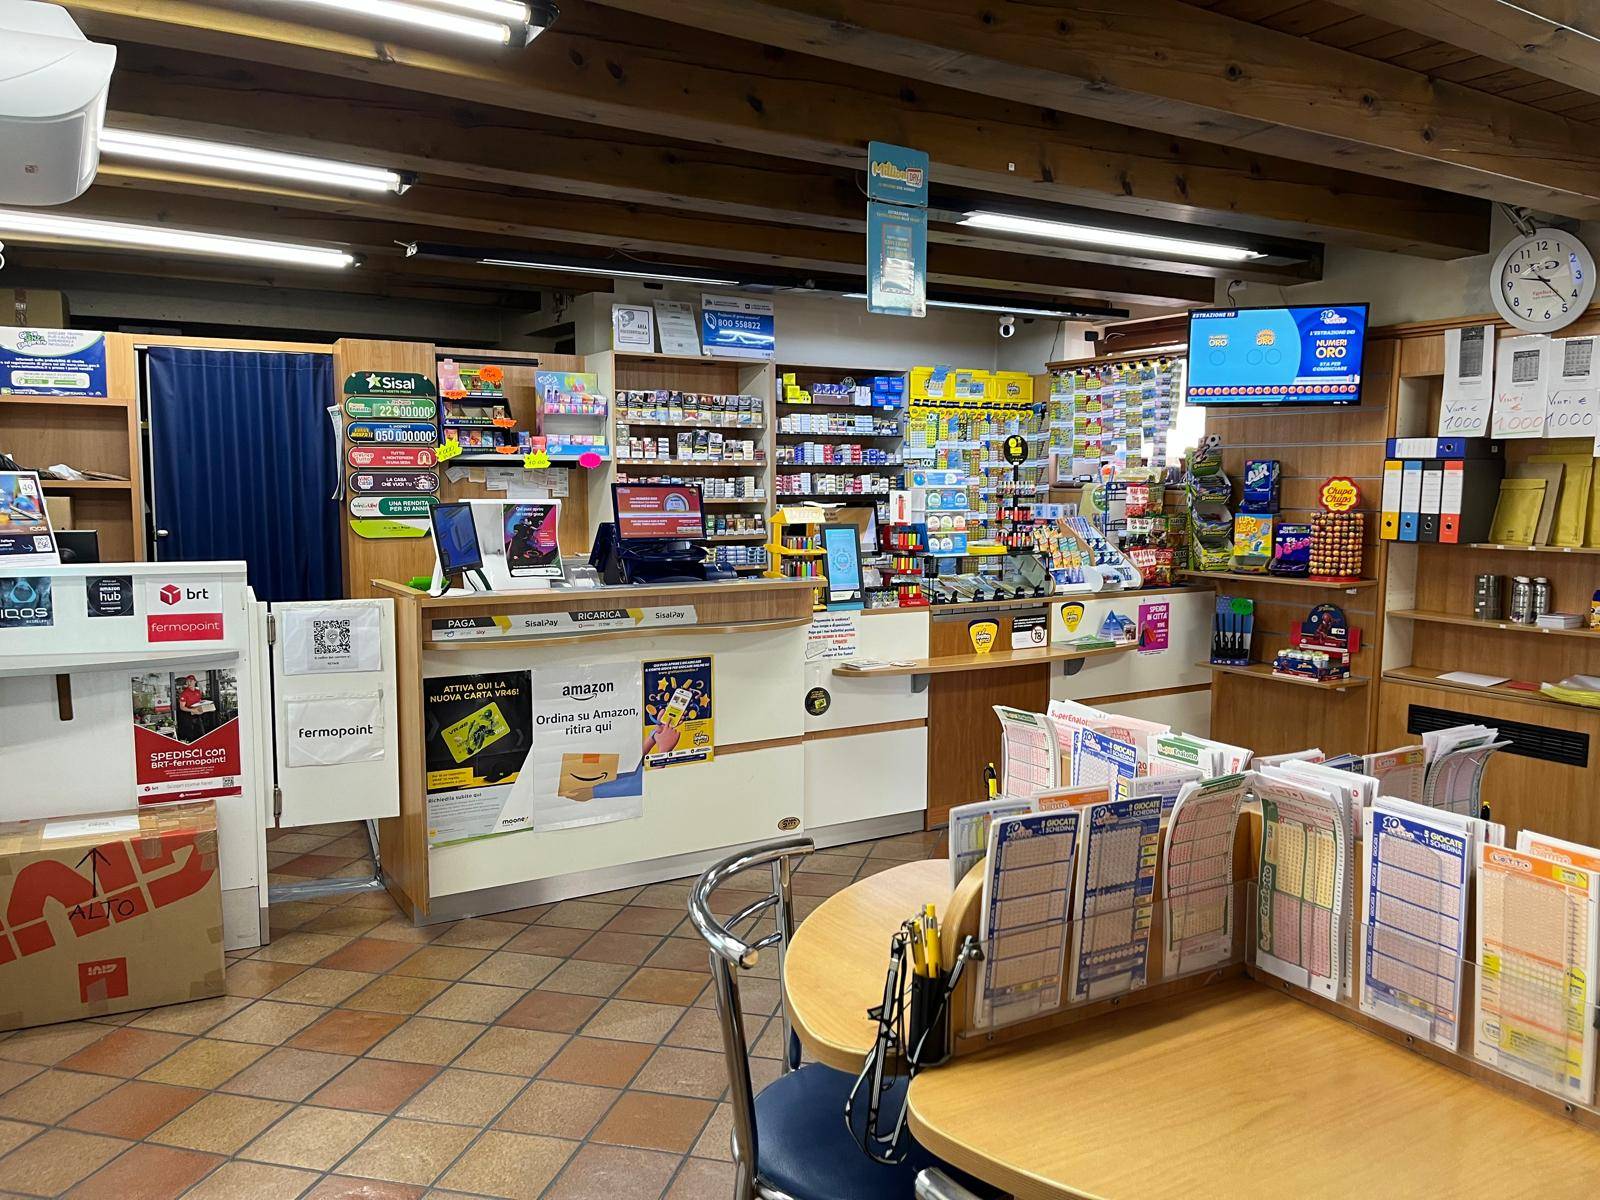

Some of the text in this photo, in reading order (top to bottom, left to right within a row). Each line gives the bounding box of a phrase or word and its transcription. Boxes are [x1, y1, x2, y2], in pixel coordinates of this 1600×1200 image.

[1536, 241, 1548, 251] 12
[1556, 243, 1561, 253] 1
[1520, 249, 1531, 260] 11
[1569, 253, 1577, 263] 2
[1509, 264, 1520, 274] 10
[1575, 270, 1582, 280] 3
[1507, 281, 1514, 291] 9
[1571, 288, 1578, 298] 4
[1513, 297, 1520, 307] 8
[1527, 308, 1533, 318] 7
[1561, 303, 1568, 313] 5
[1544, 310, 1551, 320] 6
[718, 319, 761, 330] 800 558822
[1209, 339, 1228, 347] ORO
[1256, 338, 1275, 346] ORO
[1316, 339, 1348, 347] NUMERI
[1315, 346, 1347, 359] ORO
[382, 377, 415, 390] Sisal
[1327, 486, 1354, 495] Chupa
[1325, 494, 1352, 503] Chups
[99, 591, 121, 602] hub
[186, 587, 209, 600] brt
[0, 607, 48, 620] IQOS
[1149, 605, 1167, 613] SPENDI
[577, 610, 622, 620] RICARICA
[655, 610, 685, 620] SisalPay
[151, 621, 221, 634] fermopoint
[447, 619, 477, 628] PAGA
[524, 618, 559, 629] SisalPay
[443, 681, 506, 693] ATTIVA QUI LA
[562, 682, 615, 696] amazon
[430, 688, 520, 703] NUOVA CARTA VR46!
[536, 707, 639, 726] Ordina su Amazon,
[299, 724, 373, 739] fermopoint
[565, 721, 612, 736] ritira qui
[150, 748, 226, 762] SPEDISCI con
[150, 756, 227, 769] BRT-fermopoint!
[1137, 761, 1147, 770] 20
[1133, 801, 1161, 811] GIOCATE
[1133, 808, 1160, 817] SCHEDINA
[1046, 817, 1076, 827] GIOCATE
[1046, 825, 1075, 833] SCHEDINA
[1430, 832, 1463, 849] GIOCATE
[1430, 839, 1463, 856] SCHEDINA
[68, 898, 135, 921] ALTO
